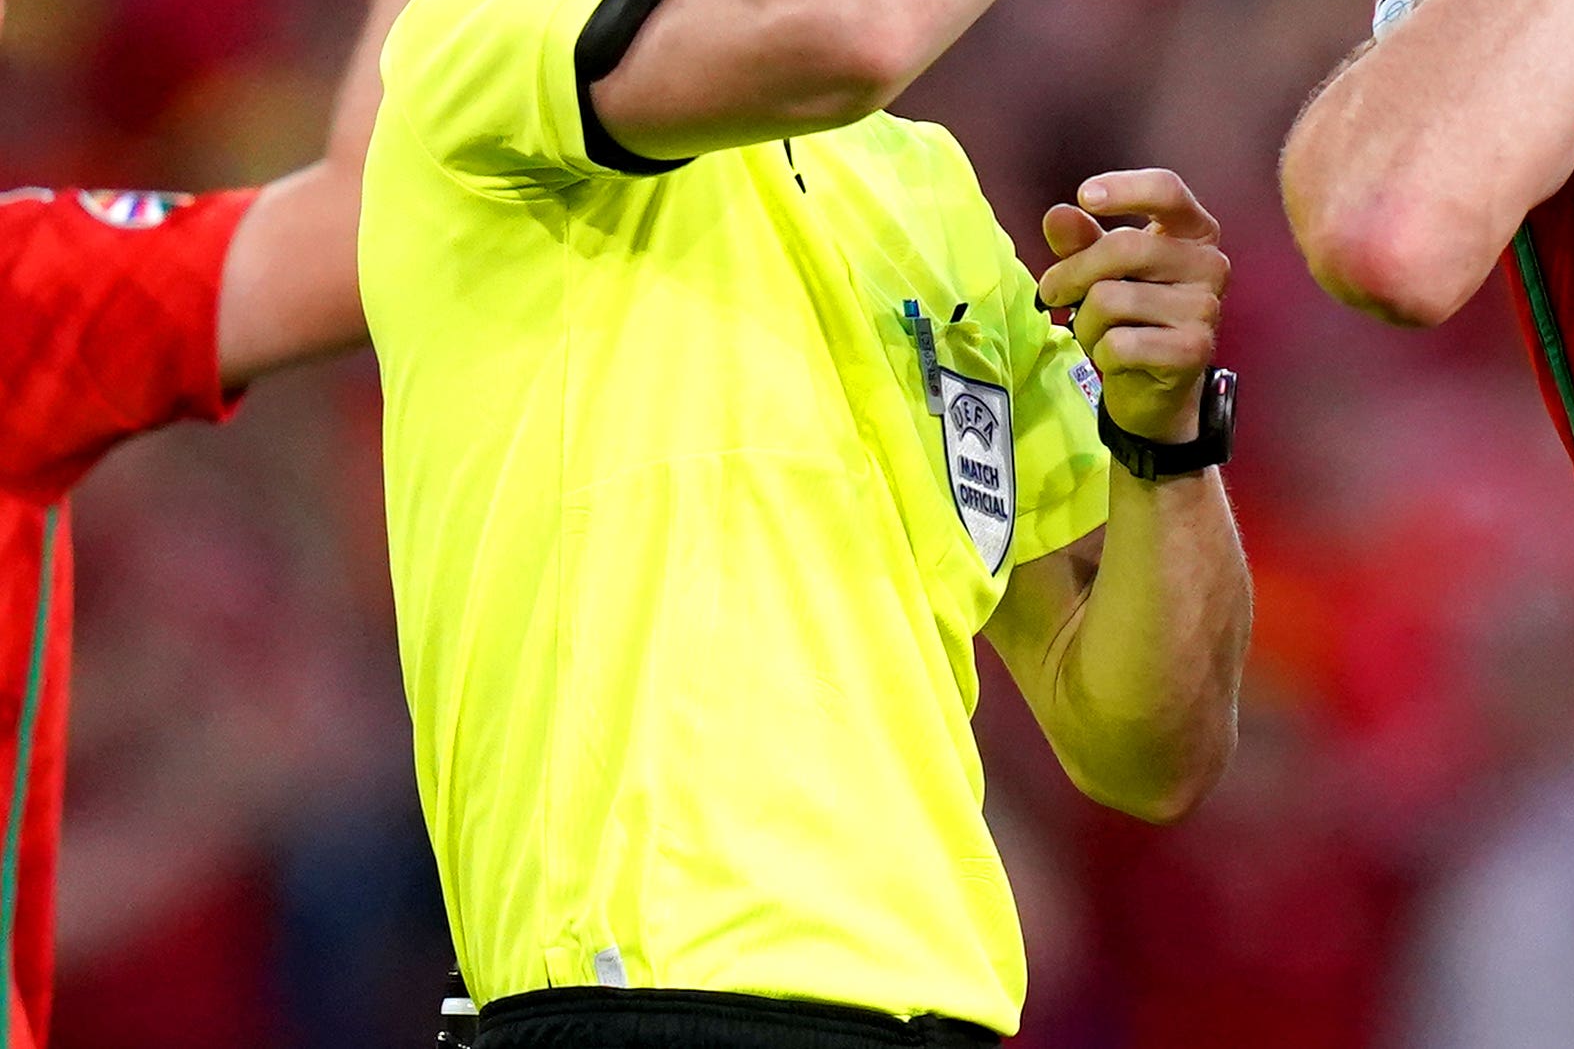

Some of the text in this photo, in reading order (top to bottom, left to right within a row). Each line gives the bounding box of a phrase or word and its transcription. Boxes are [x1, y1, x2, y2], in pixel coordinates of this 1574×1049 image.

[949, 400, 995, 445] UEFA
[958, 454, 1000, 491] MATCH
[958, 482, 1009, 522] OFFICIAL
